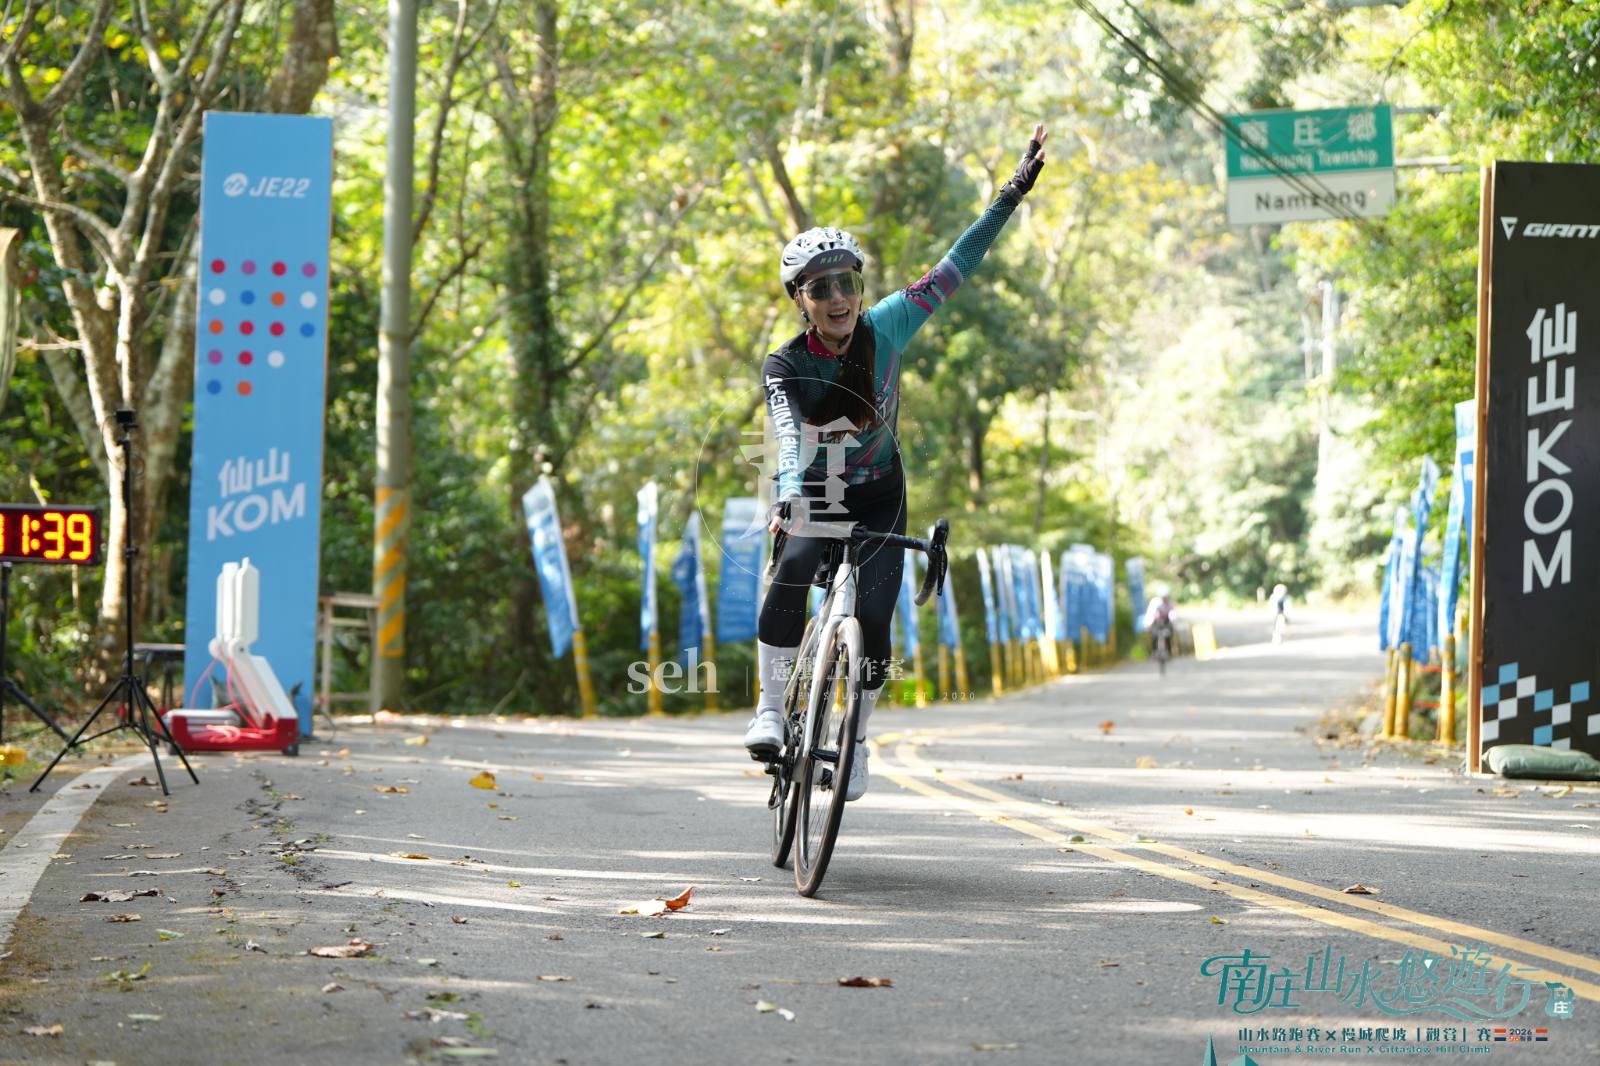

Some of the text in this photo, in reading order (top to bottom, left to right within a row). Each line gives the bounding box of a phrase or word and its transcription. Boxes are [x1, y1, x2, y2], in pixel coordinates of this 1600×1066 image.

[1318, 148, 1378, 167] Township
[249, 176, 311, 198] JE22
[1523, 222, 1600, 238] GIANT
[217, 447, 290, 498] 仙山
[206, 482, 306, 542] KOM
[0, 512, 91, 560] 1:39
